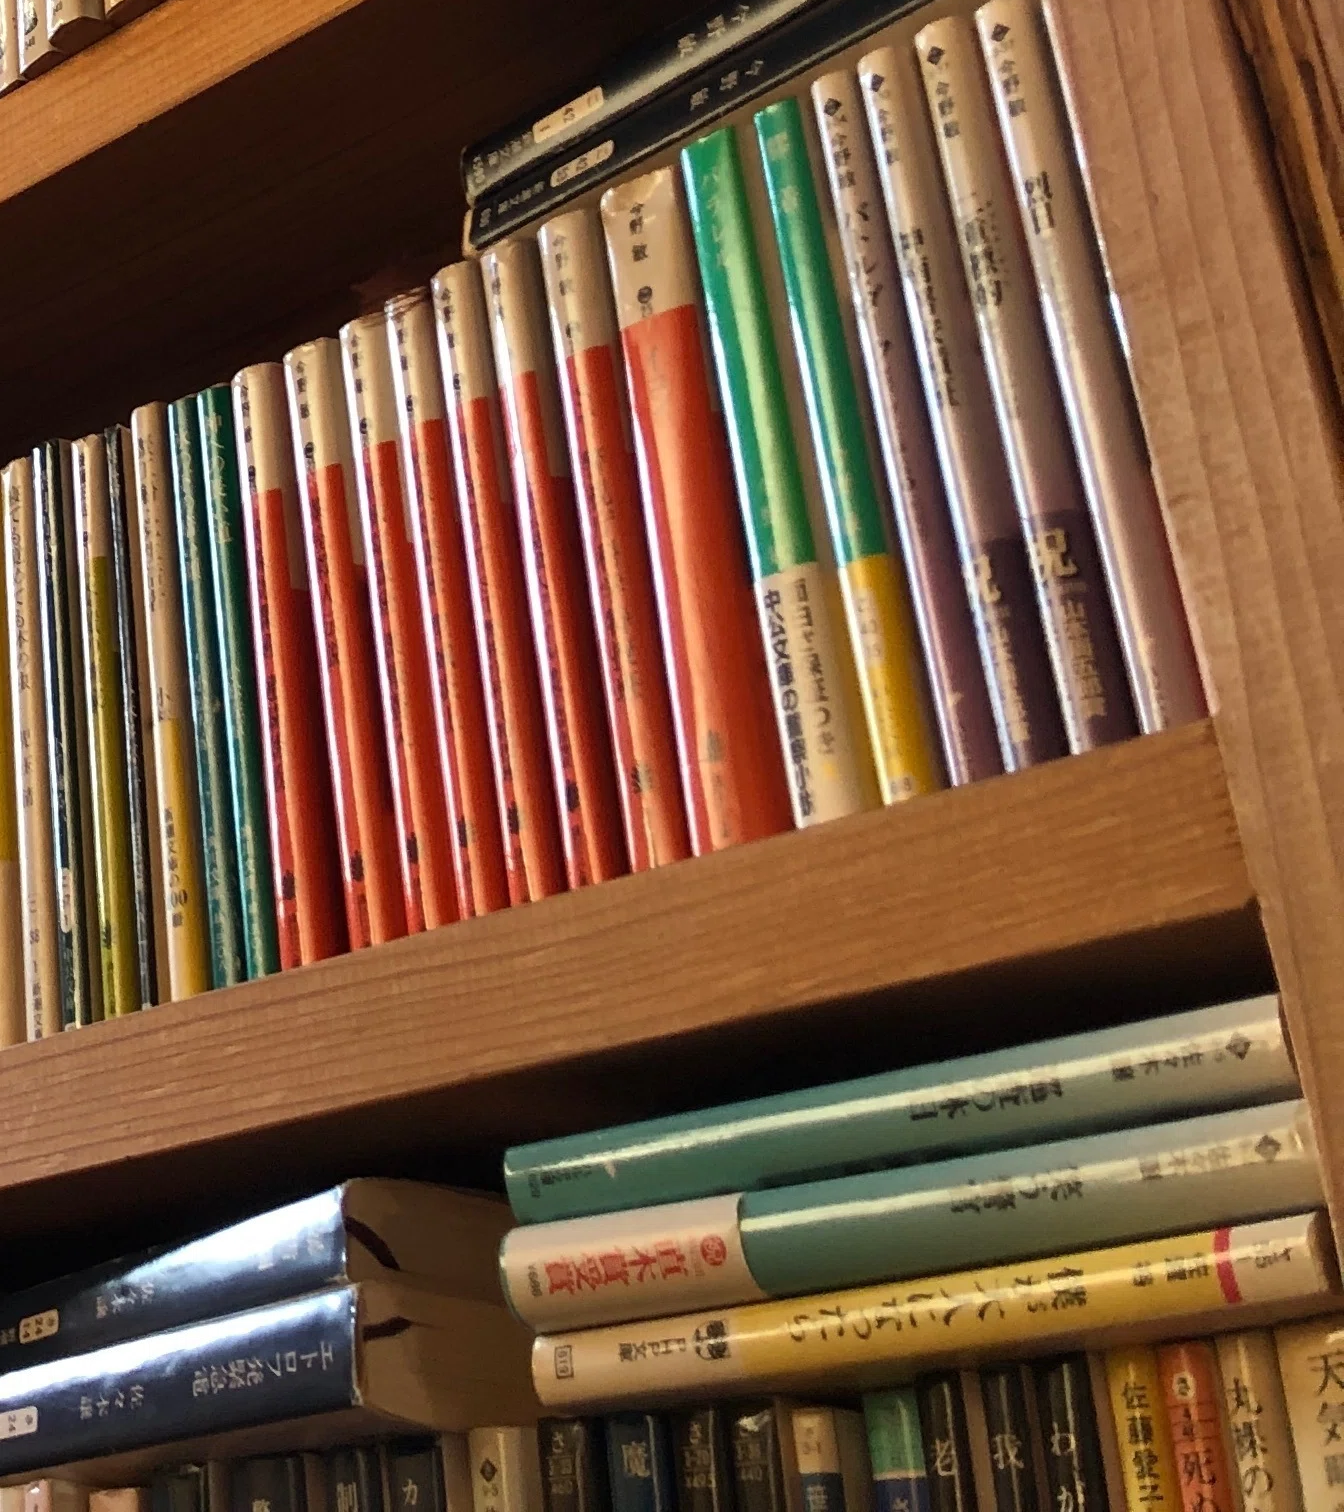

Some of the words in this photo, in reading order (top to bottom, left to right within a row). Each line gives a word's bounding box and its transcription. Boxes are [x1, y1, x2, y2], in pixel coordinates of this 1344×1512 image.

[543, 1235, 690, 1297] 直木賞受賞
[788, 1263, 1090, 1345] 僕が大人になったら
[78, 1381, 146, 1421] 佐々木譲
[192, 1341, 337, 1399] エトロフ発緊急電
[1121, 1381, 1164, 1504] 佐藤愛子
